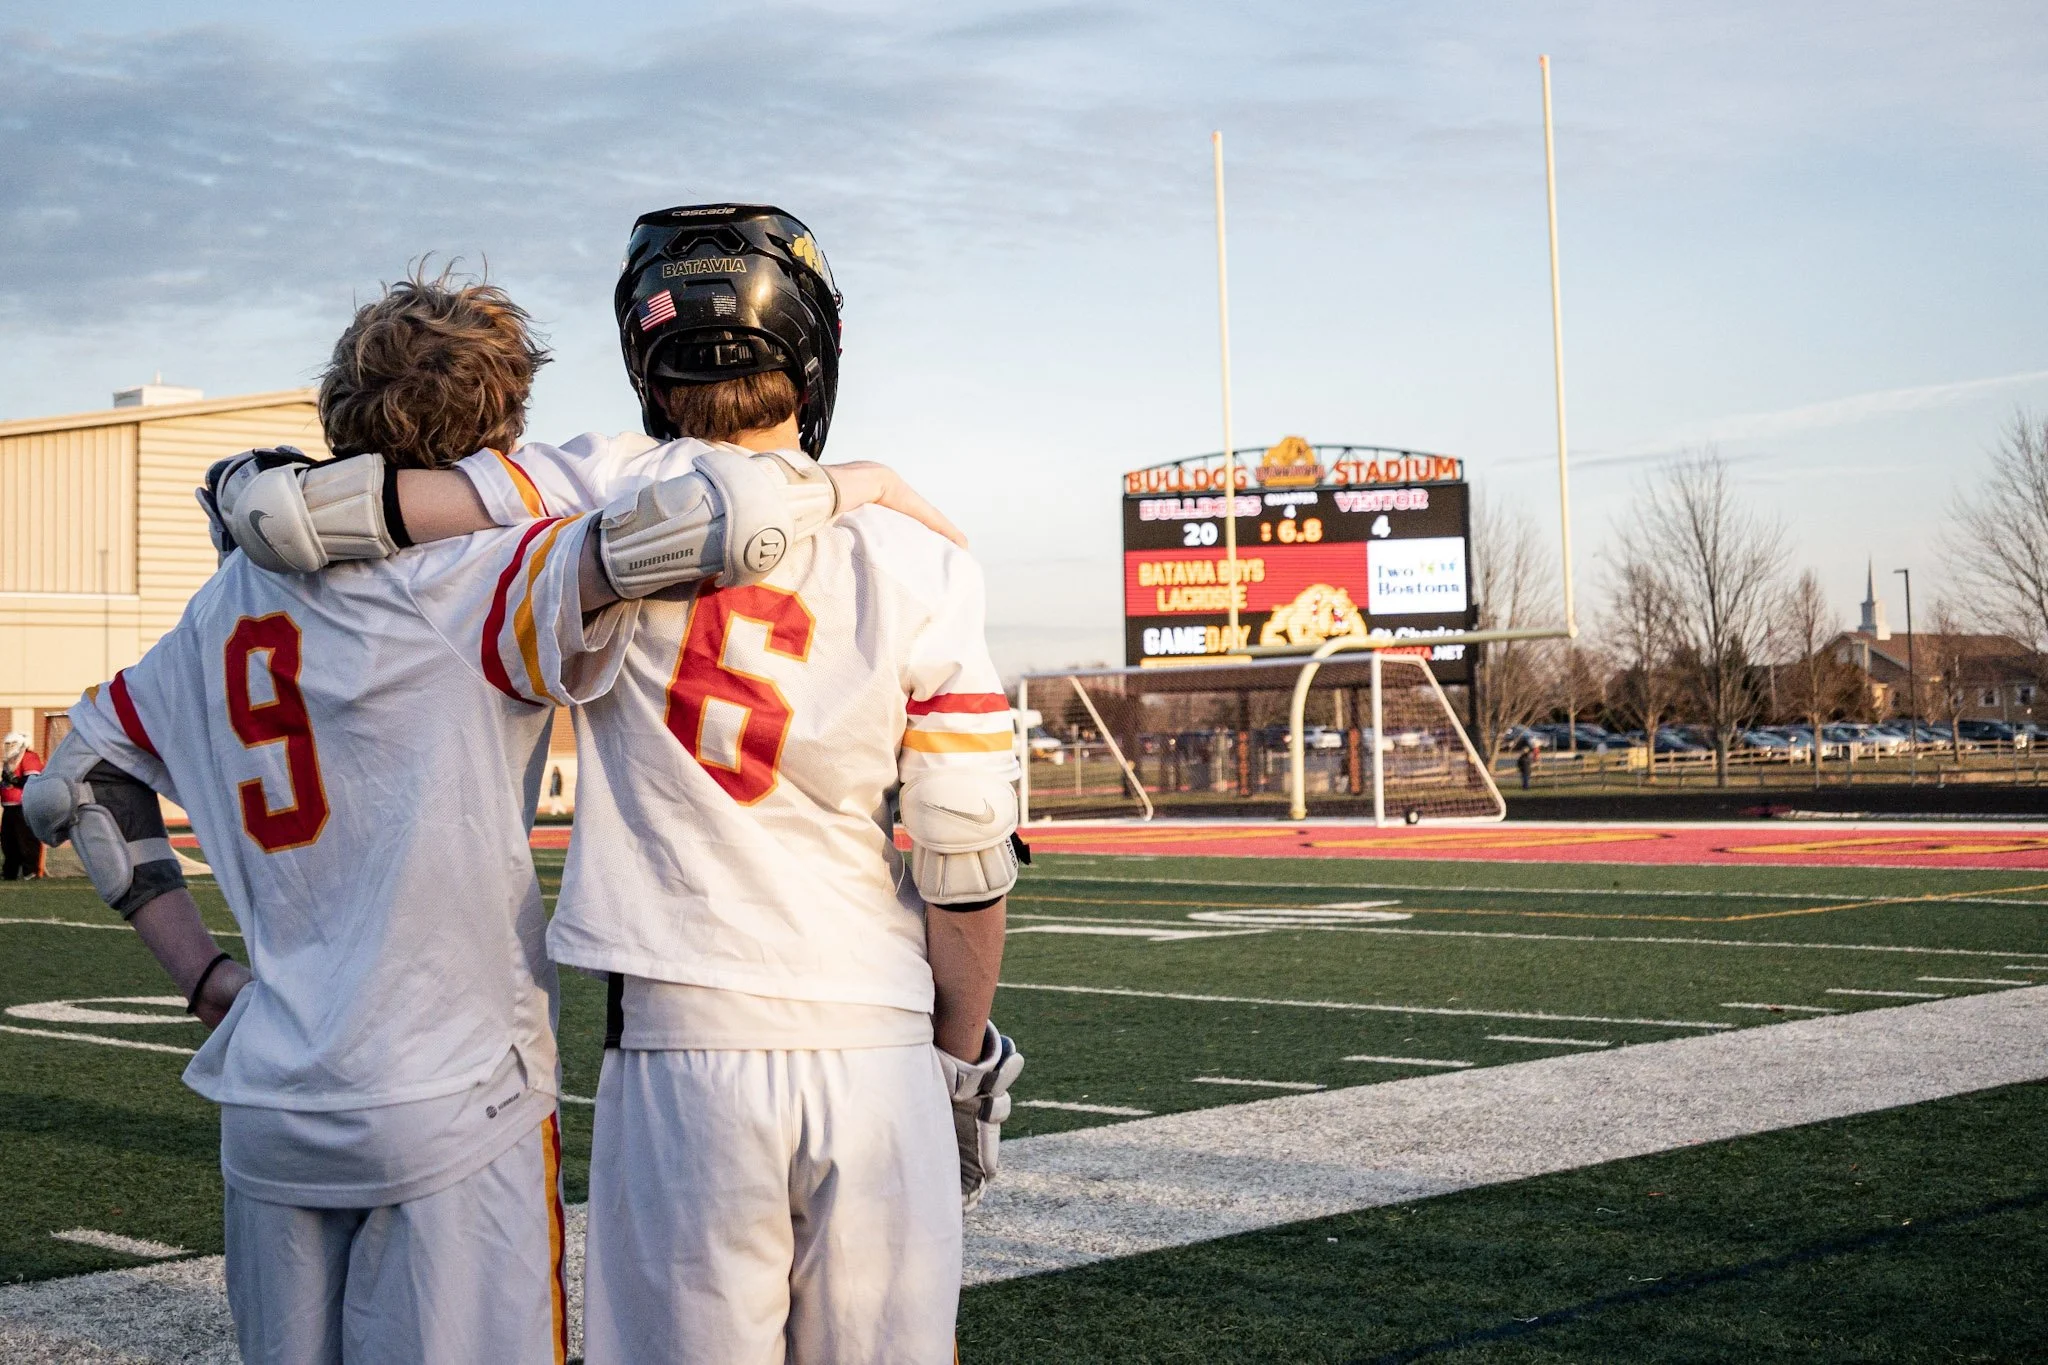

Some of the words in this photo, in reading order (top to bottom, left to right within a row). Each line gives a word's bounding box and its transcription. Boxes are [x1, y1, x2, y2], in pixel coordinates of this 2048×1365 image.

[672, 207, 737, 217] cascade
[662, 258, 747, 279] BATAVIA
[1128, 465, 1247, 493] BULLDOG
[1334, 456, 1457, 486] STADIUM
[1333, 488, 1429, 512] VISITOR
[1182, 522, 1218, 546] 20
[1371, 515, 1391, 538] 4
[629, 548, 694, 570] WARRIOR
[1138, 560, 1217, 587] BATAVIA
[1378, 582, 1459, 595] Bostons
[665, 580, 816, 807] 6
[223, 610, 330, 854] 9
